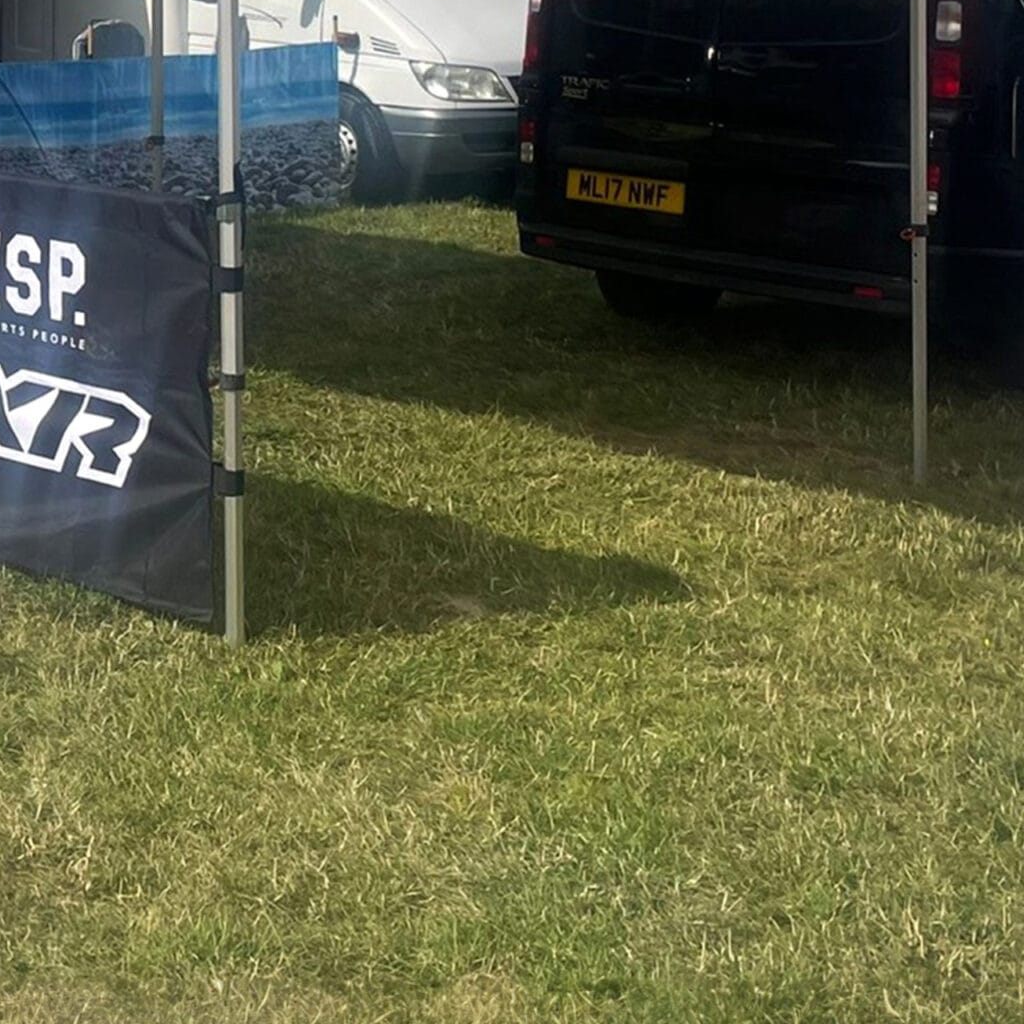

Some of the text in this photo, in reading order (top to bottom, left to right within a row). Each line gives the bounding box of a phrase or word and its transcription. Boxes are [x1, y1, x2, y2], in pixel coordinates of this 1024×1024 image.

[578, 173, 670, 207] ML17 NWF
[32, 329, 86, 351] PEOPLE
